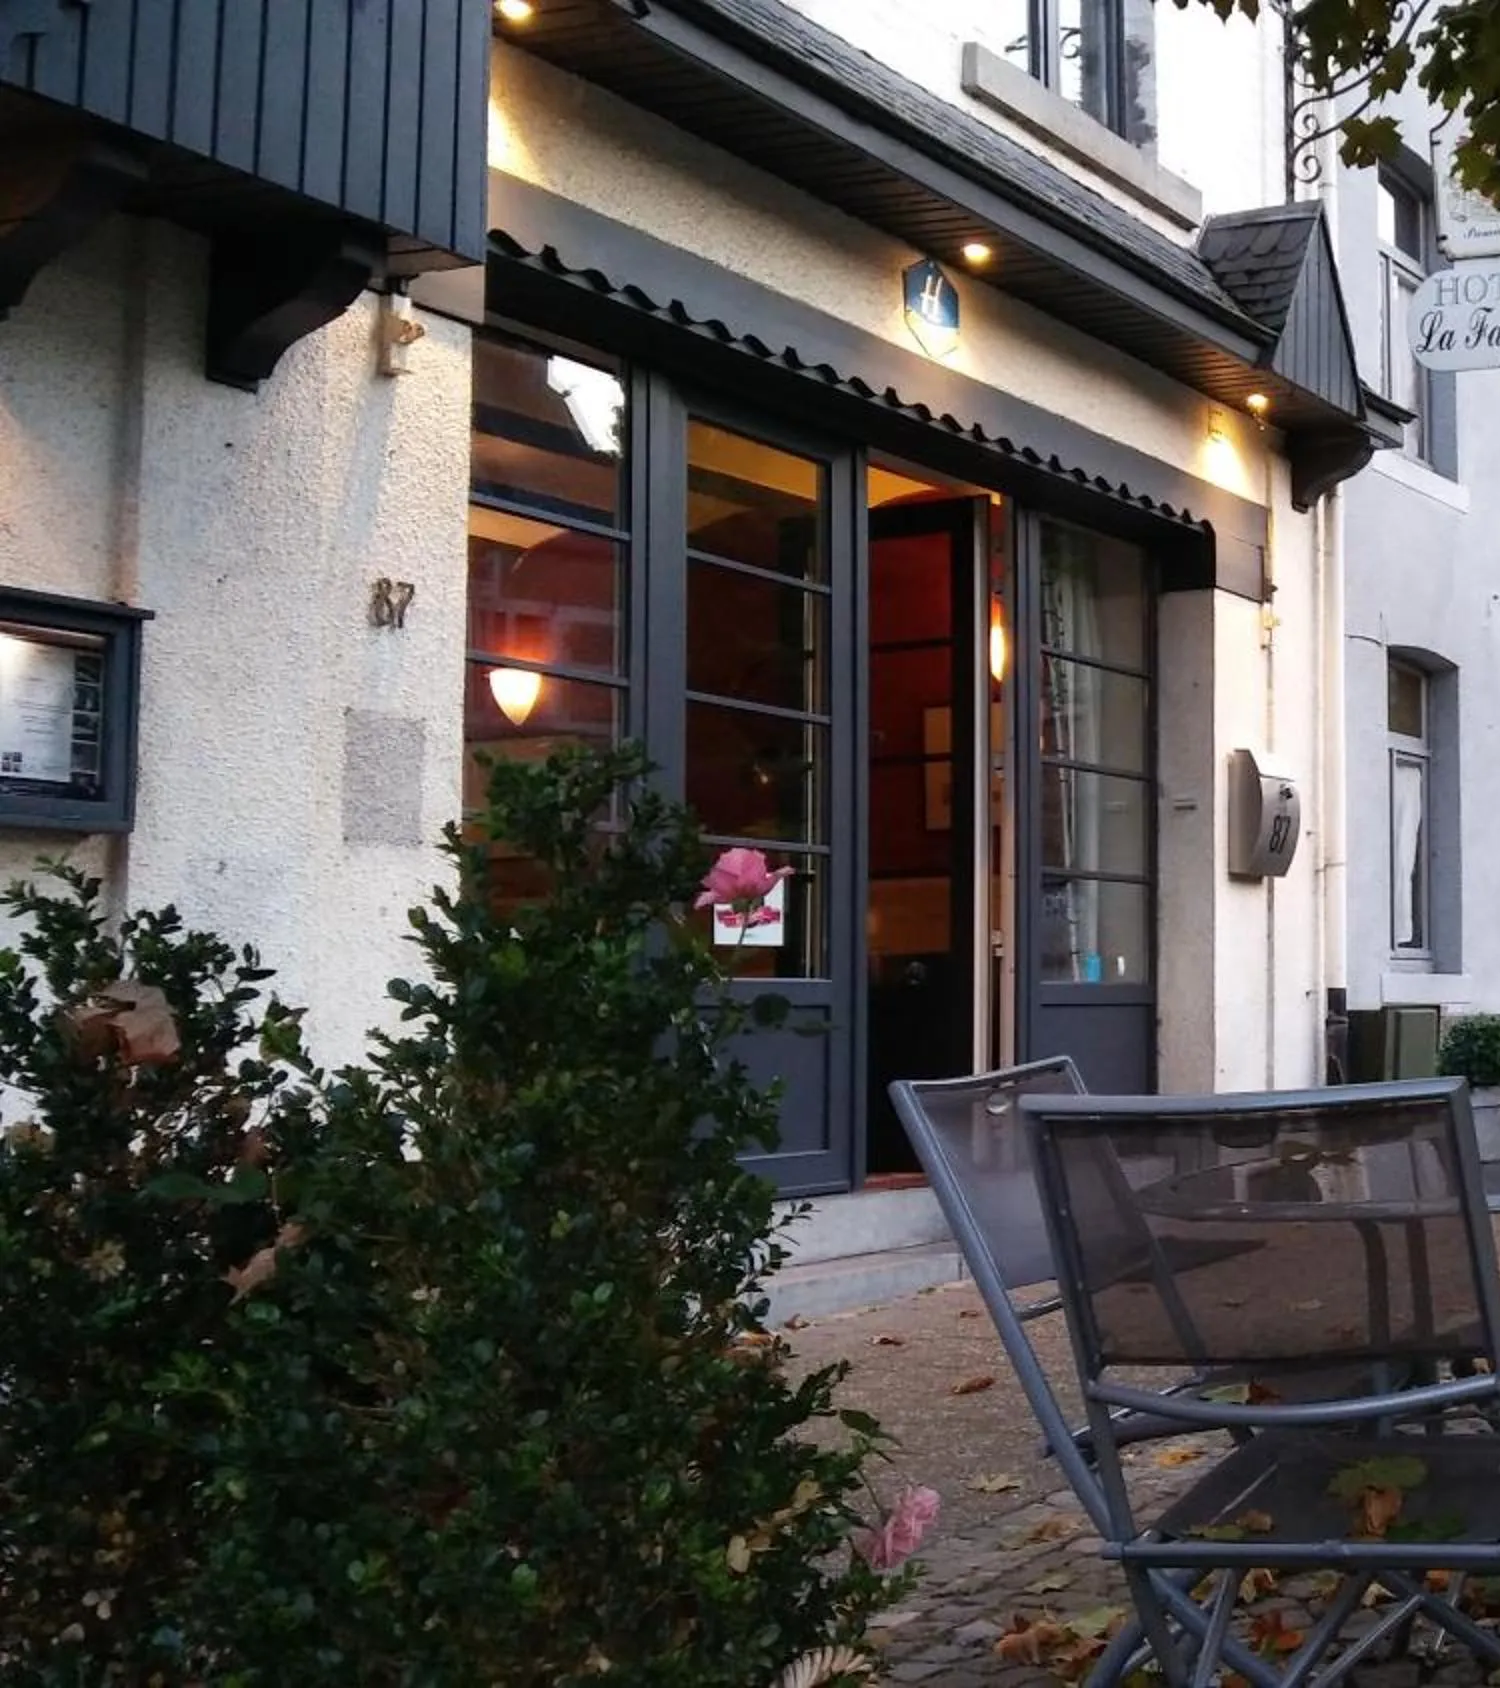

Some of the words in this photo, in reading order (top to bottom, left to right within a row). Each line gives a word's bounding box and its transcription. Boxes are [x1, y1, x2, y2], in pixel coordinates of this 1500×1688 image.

[1416, 310, 1456, 354] La
[367, 577, 415, 629] 87
[1269, 814, 1292, 854] 87
